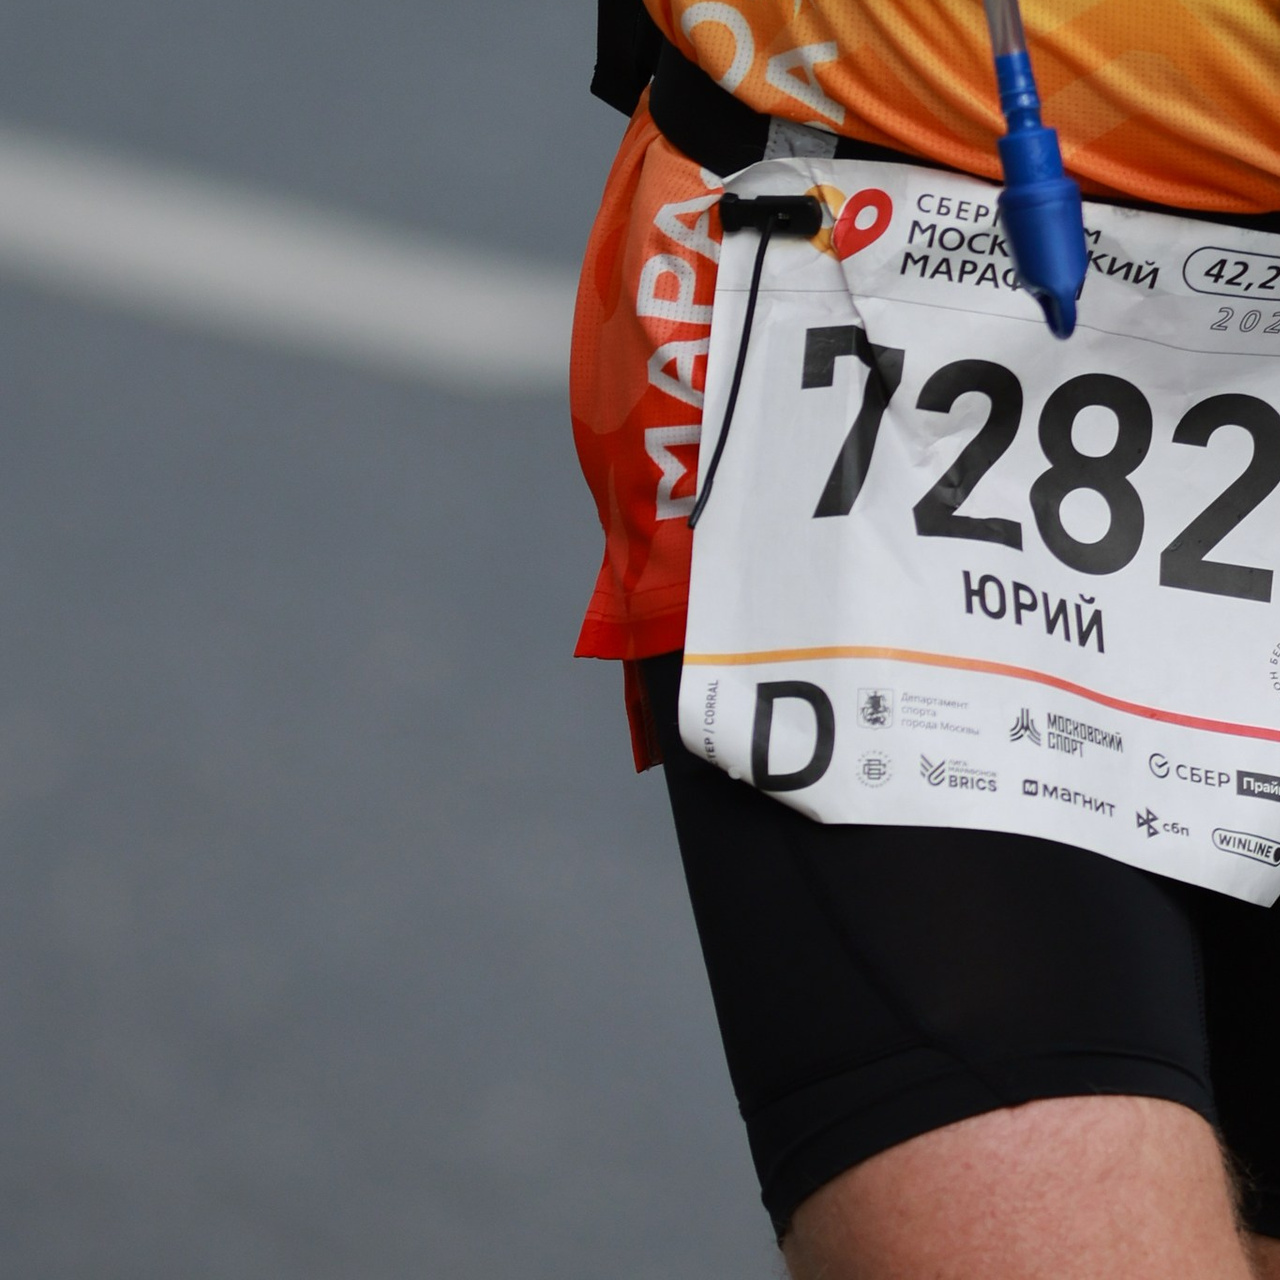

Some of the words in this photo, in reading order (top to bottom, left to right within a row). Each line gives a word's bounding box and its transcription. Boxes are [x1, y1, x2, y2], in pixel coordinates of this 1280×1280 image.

[907, 220, 1160, 290] МОСККИЙ
[962, 570, 1106, 654] ЮРИЙ
[751, 680, 836, 792] D
[1047, 712, 1124, 753] МОСКОВСКИЙ
[1047, 731, 1084, 758] СПОРТ
[948, 774, 998, 793] BRICS
[1175, 764, 1231, 788] СБЕР
[1218, 832, 1274, 859] WINLINE
